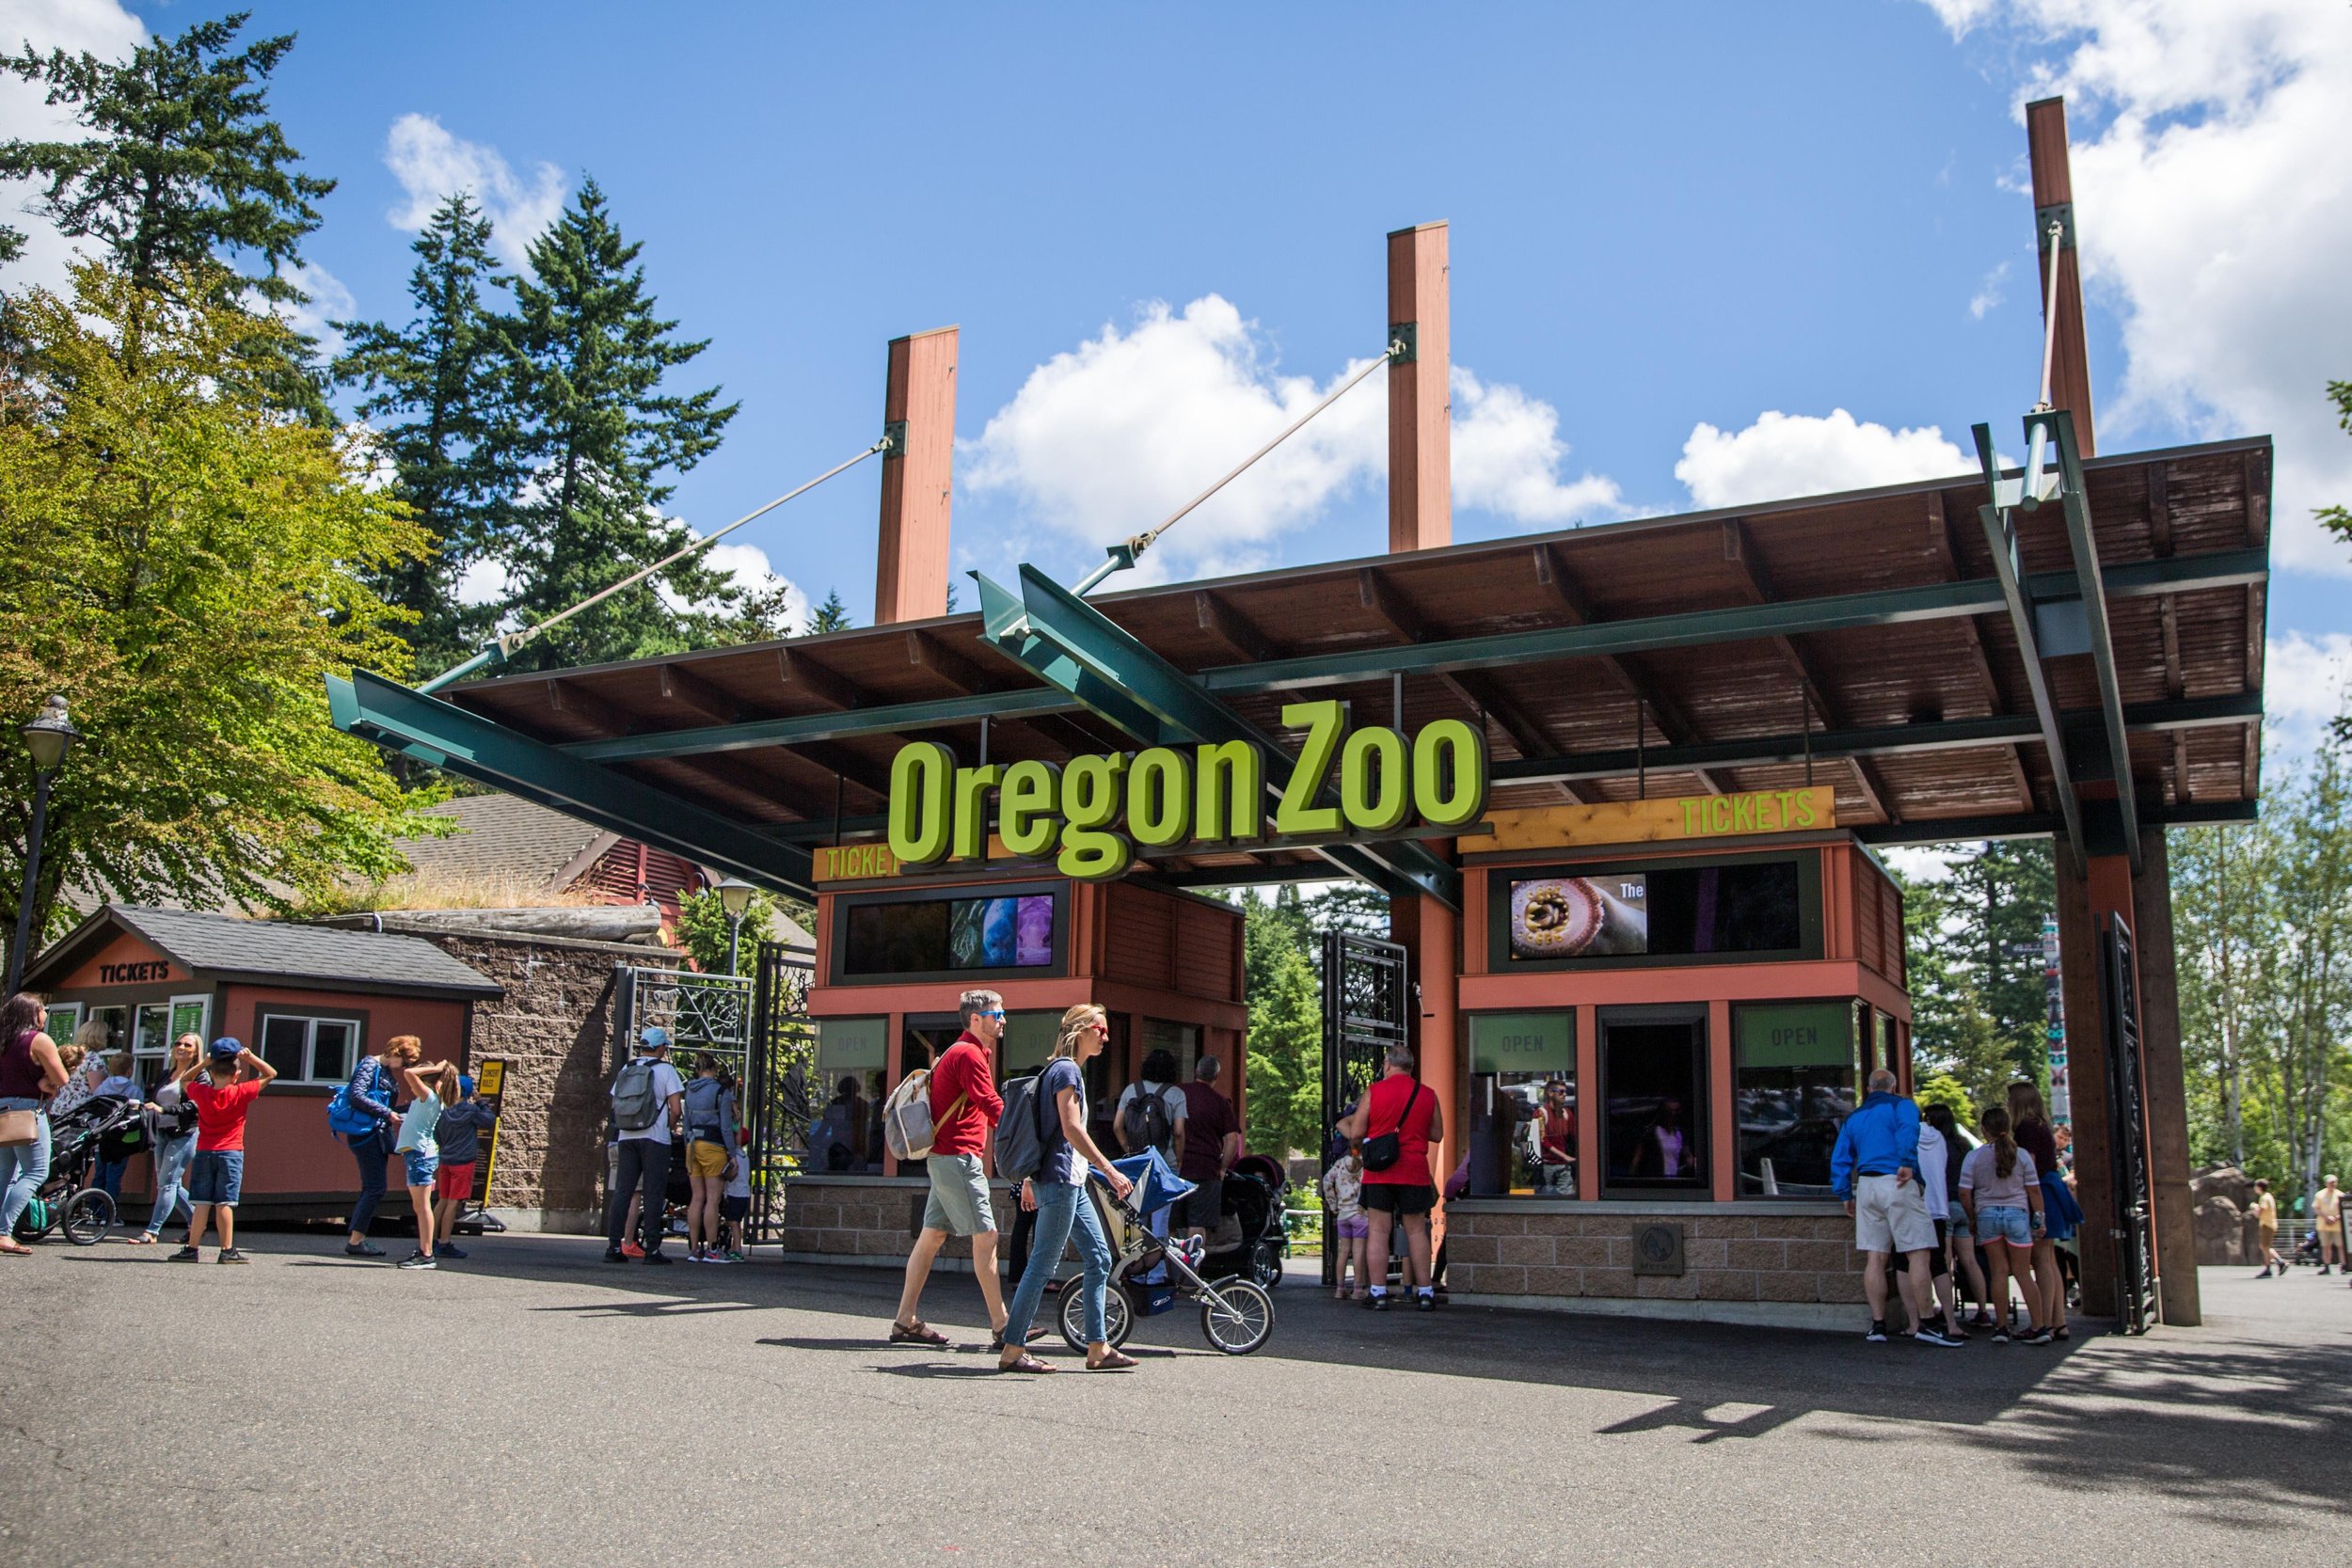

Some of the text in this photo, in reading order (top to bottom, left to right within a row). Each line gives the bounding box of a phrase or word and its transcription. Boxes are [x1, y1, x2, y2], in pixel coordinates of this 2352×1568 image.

[888, 699, 1483, 879] Oregon Zoo
[1679, 790, 1817, 835] TICKETS
[827, 846, 898, 878] TICKET
[1620, 882, 1645, 898] The
[100, 960, 169, 984] TICKETS
[838, 1037, 866, 1052] OPEN
[1029, 1033, 1055, 1049] OPE
[1502, 1036, 1544, 1053] OPEN
[1772, 1026, 1818, 1046] OPEN
